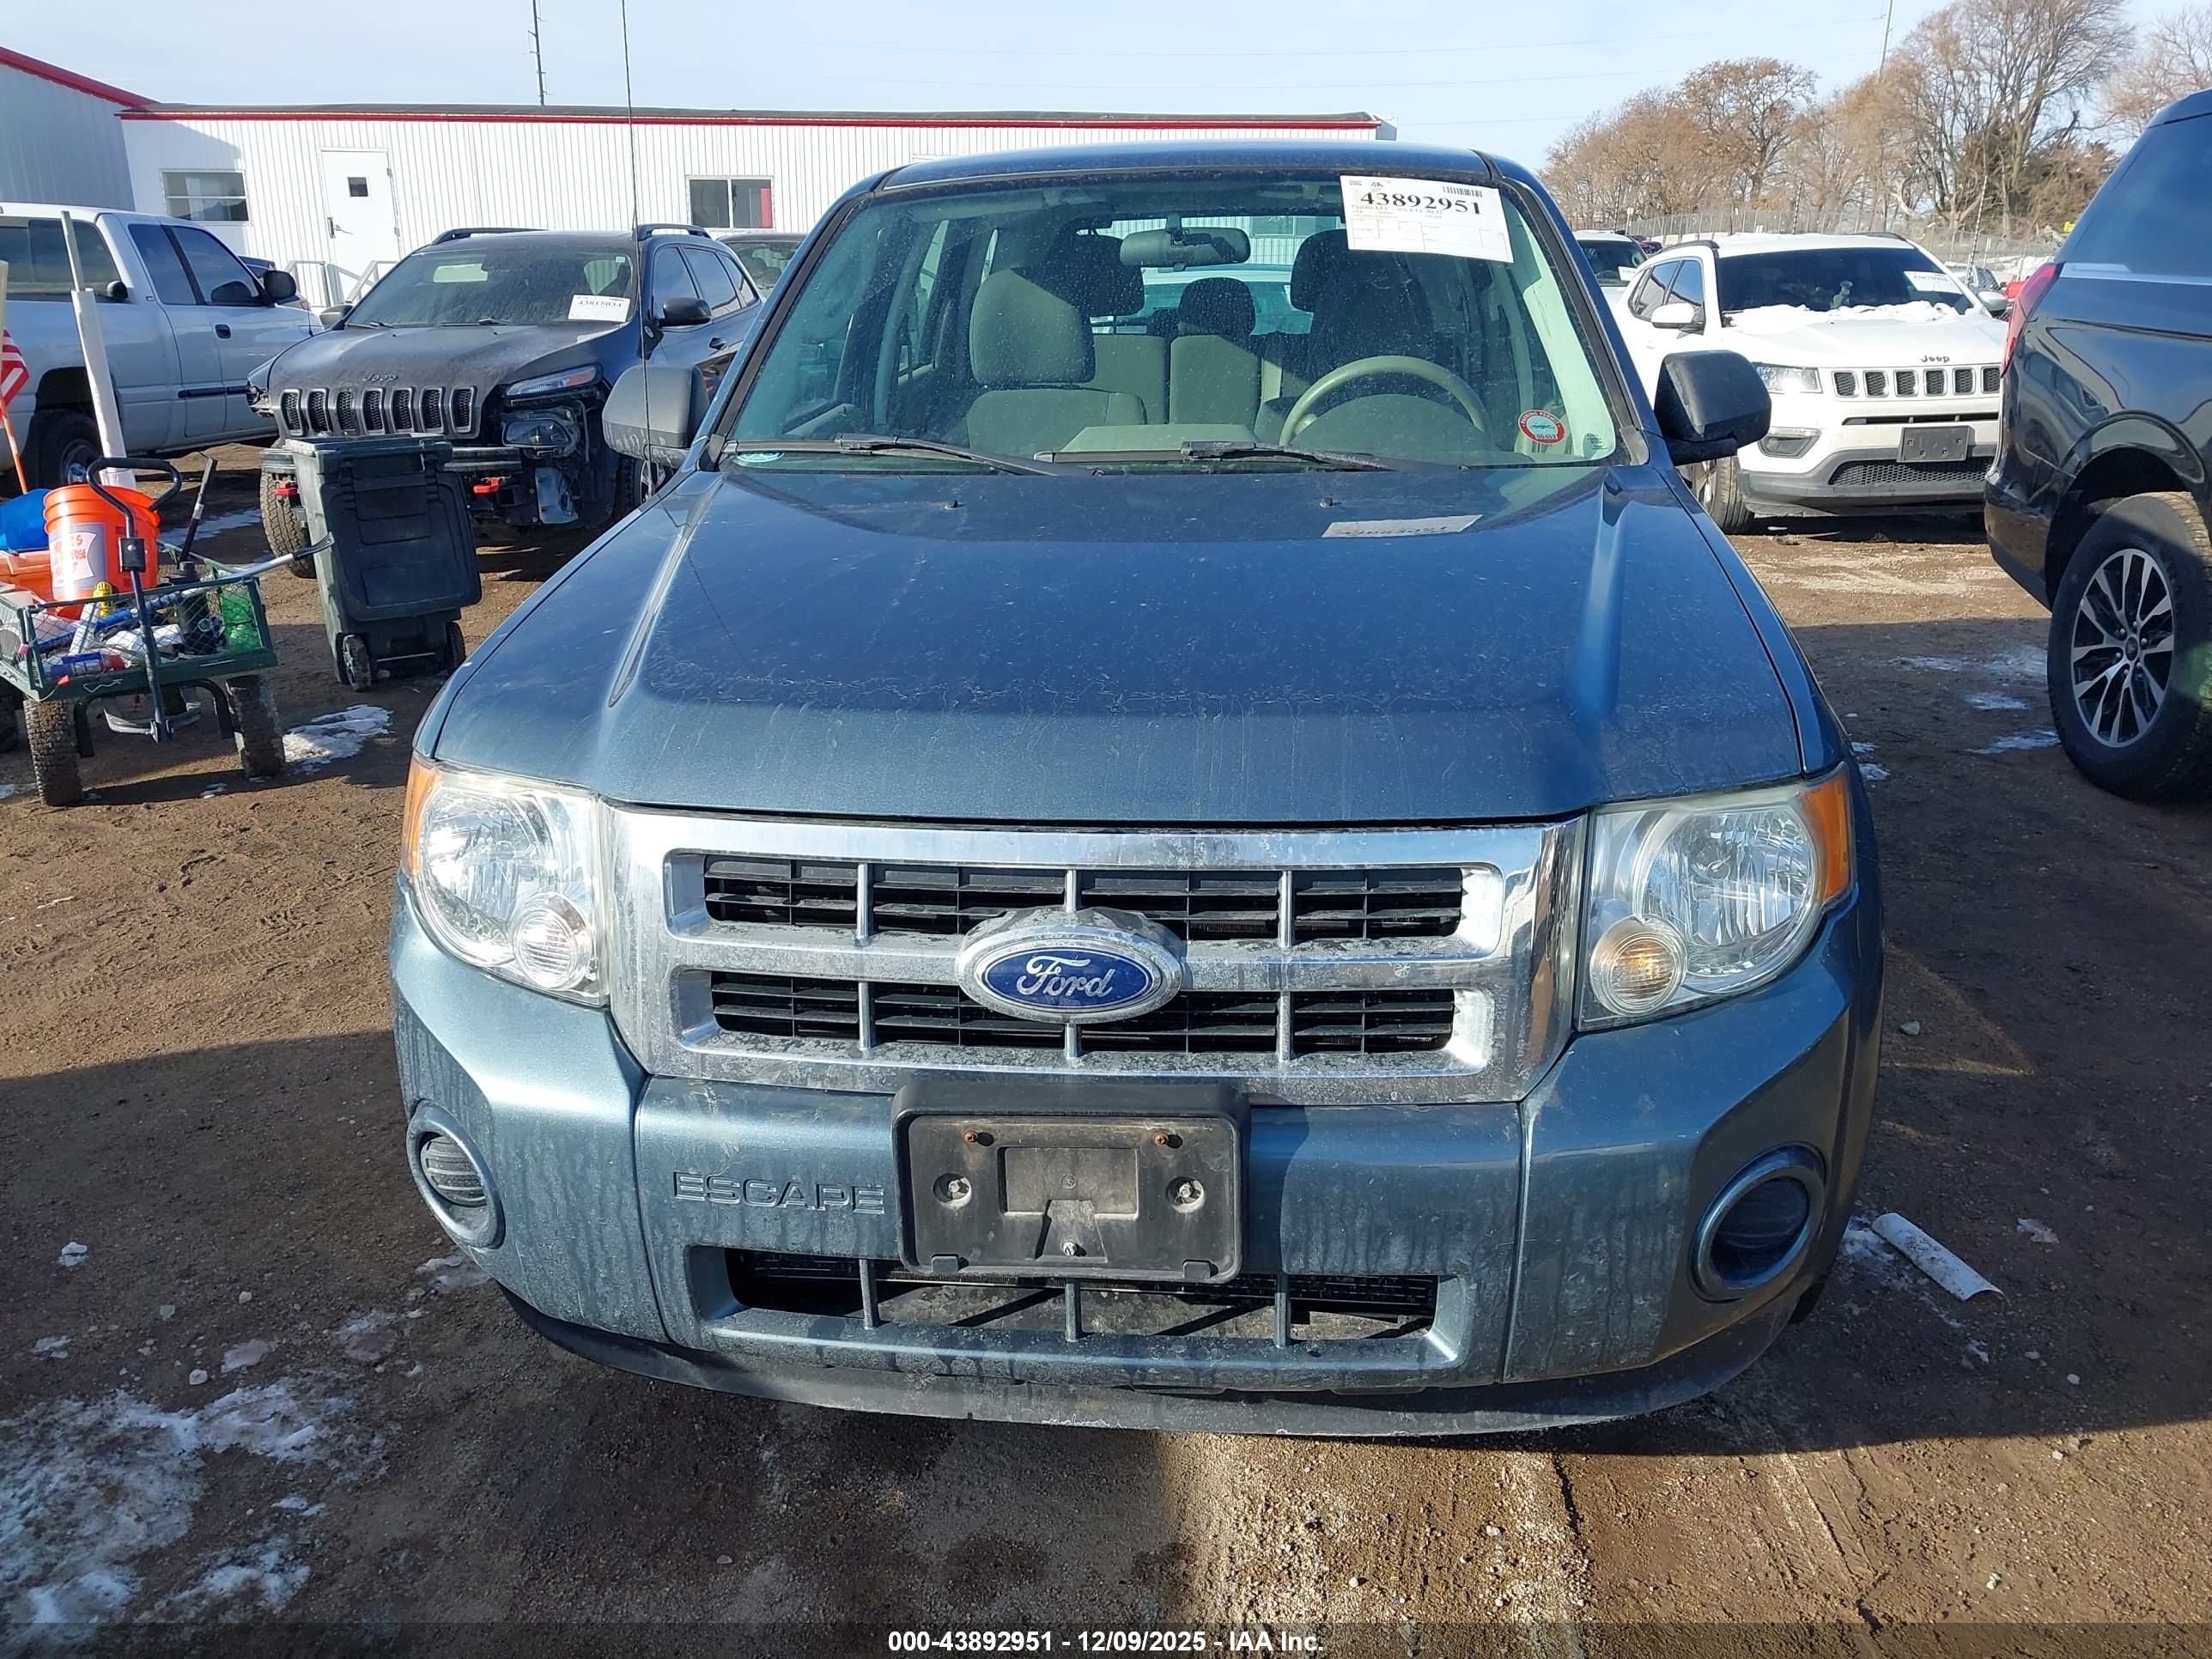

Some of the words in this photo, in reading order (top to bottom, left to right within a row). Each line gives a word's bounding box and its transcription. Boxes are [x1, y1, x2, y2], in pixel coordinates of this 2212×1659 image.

[1360, 191, 1482, 215] 43892951
[1920, 354, 1950, 363] Jeep
[1016, 955, 1116, 998] Ford
[672, 1170, 885, 1214] ESCAPE
